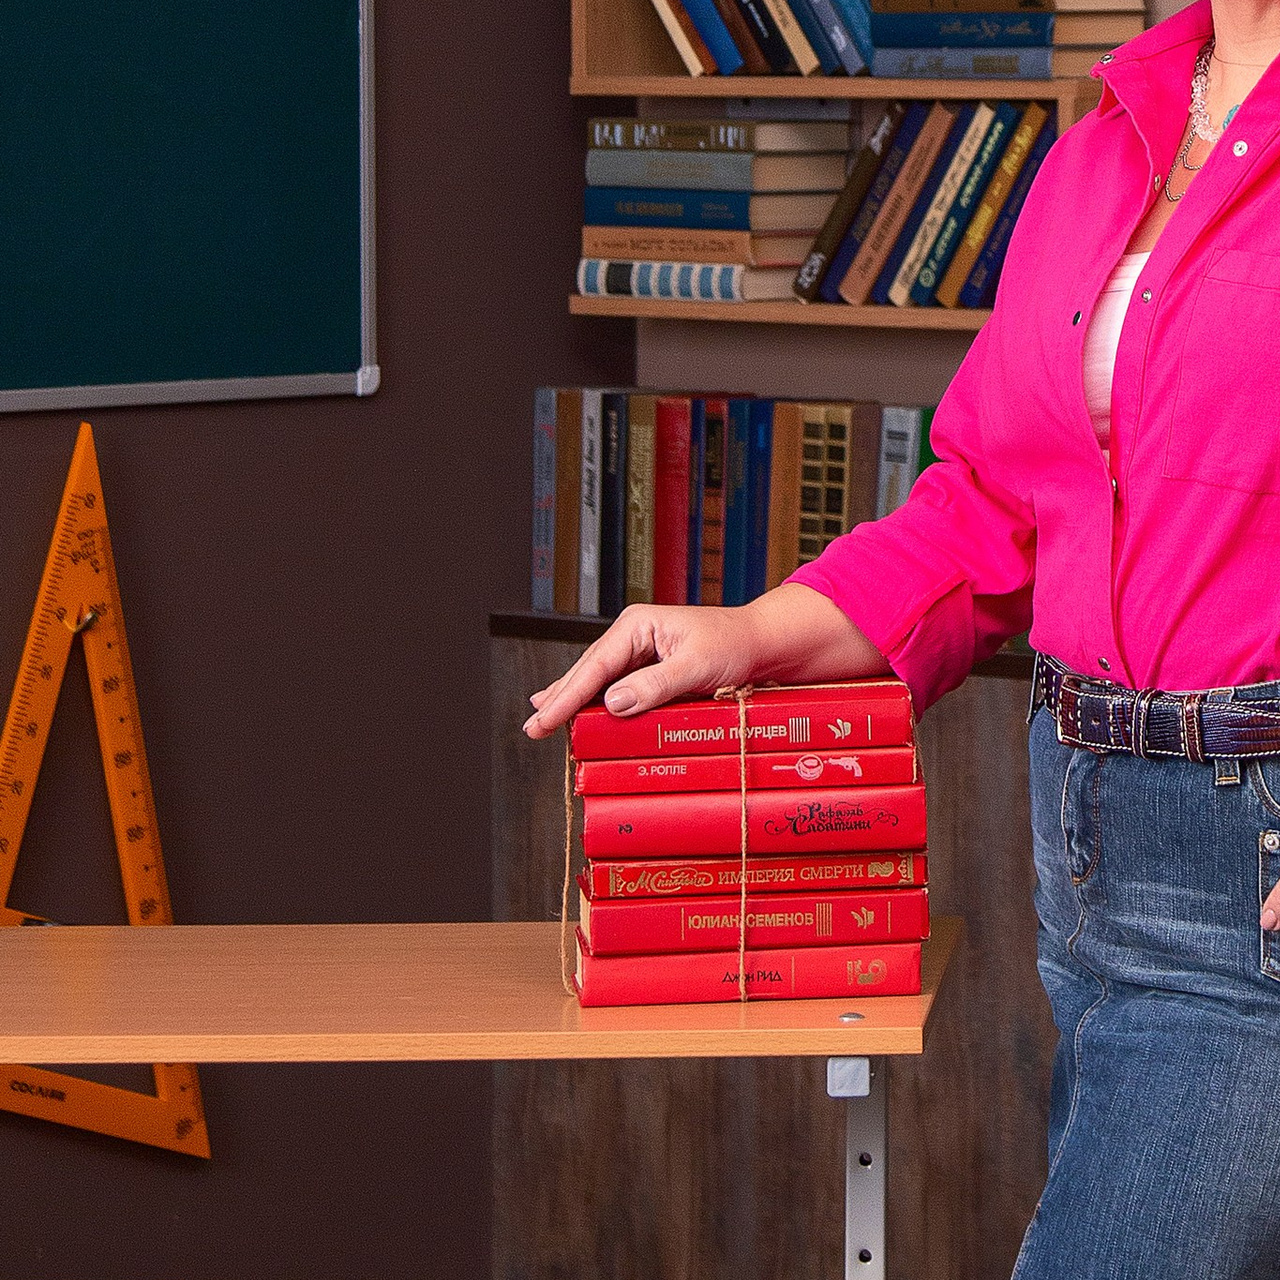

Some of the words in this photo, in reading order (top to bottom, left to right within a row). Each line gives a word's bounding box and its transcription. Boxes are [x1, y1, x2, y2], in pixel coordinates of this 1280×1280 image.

[664, 726, 725, 742] НИКОЛАЙ
[637, 765, 649, 776] Э.
[650, 764, 687, 776] РОЛЛЕ
[718, 868, 796, 885] ИМПЕРИЯ
[799, 864, 864, 881] СМЕРТИ
[688, 914, 741, 929] ЮЛИАН
[746, 912, 814, 927] СЕМЕНОВ
[756, 970, 783, 983] РИД
